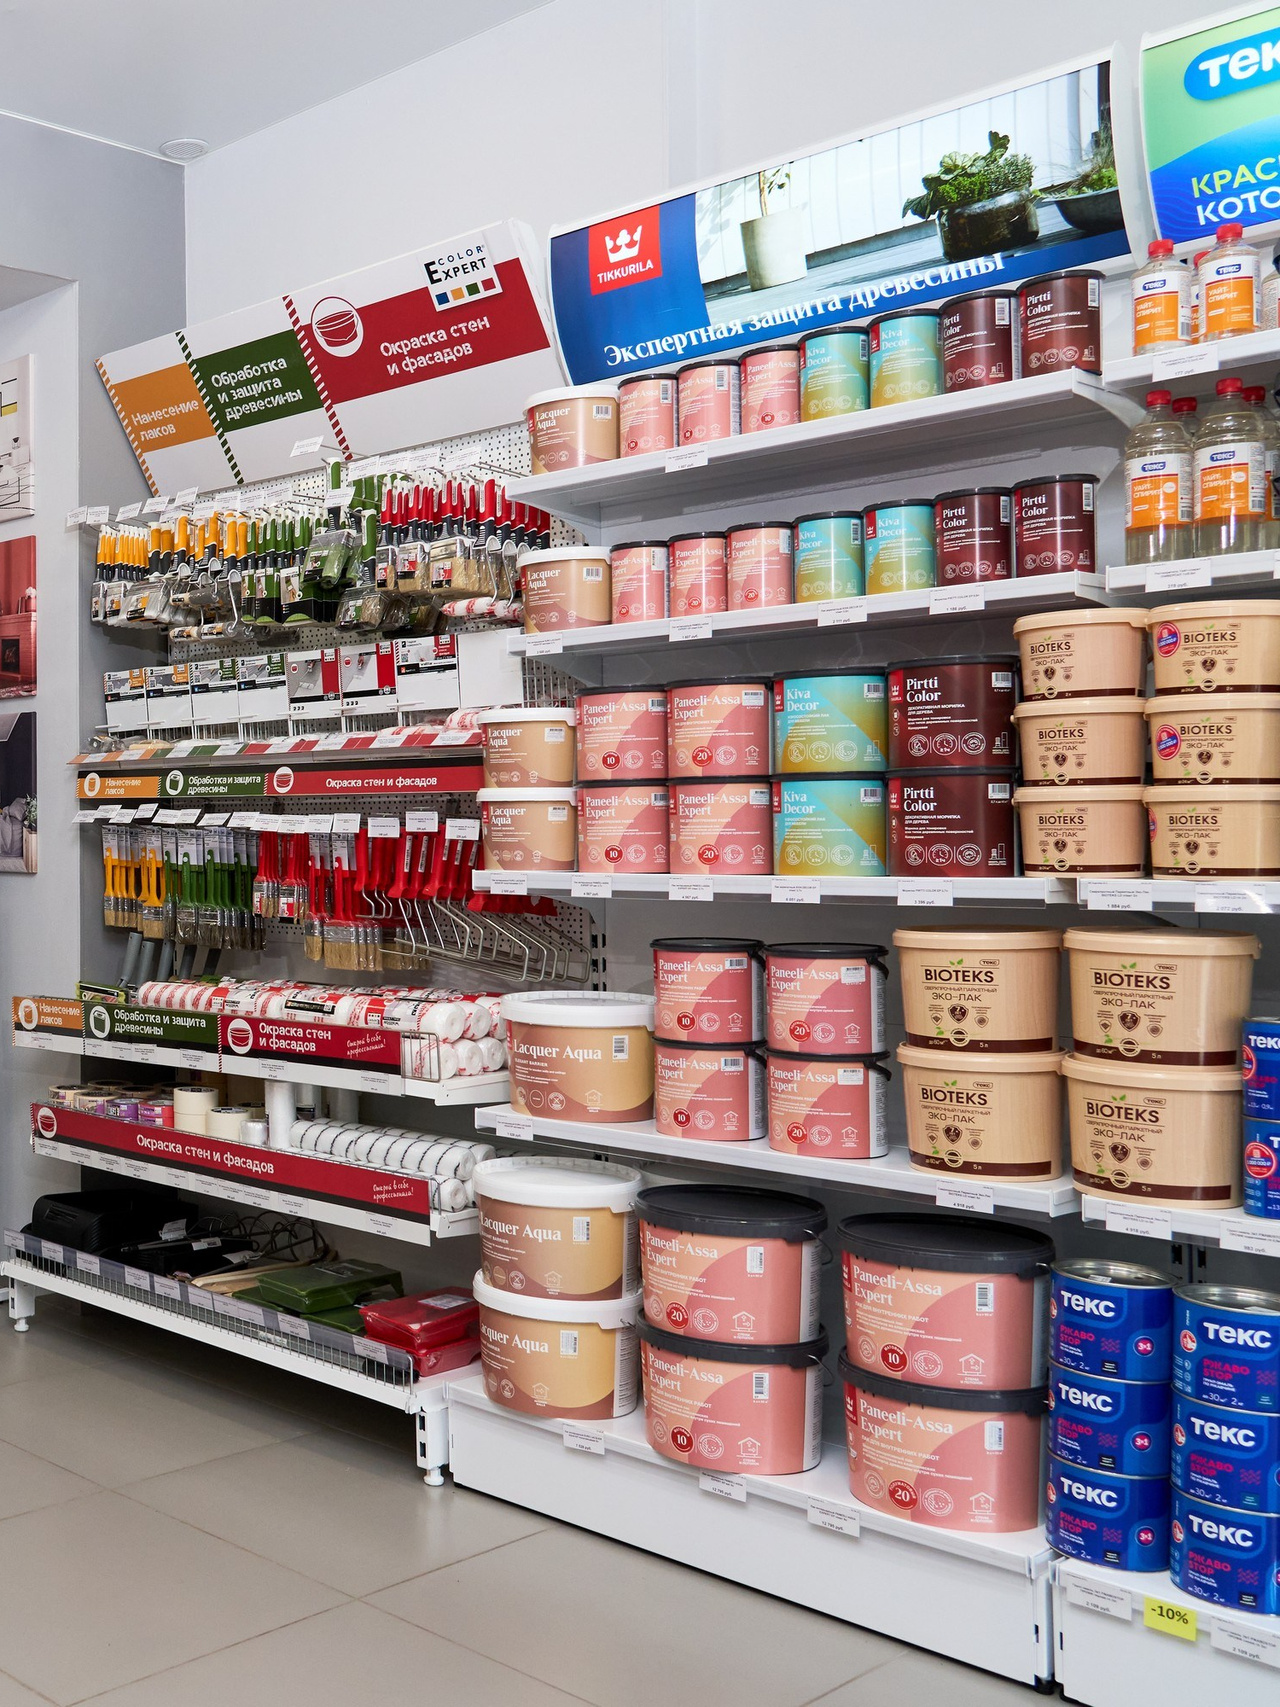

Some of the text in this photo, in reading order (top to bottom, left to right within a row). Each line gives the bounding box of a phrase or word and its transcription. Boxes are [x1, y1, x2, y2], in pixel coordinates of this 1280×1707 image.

[1192, 157, 1280, 198] КРАС
[597, 259, 654, 285] TIKKURILA
[1026, 291, 1051, 307] Pirtti
[604, 252, 1007, 367] Экспертная защита древесины
[1026, 302, 1053, 317] Color
[379, 315, 491, 358] Окраска стен
[387, 341, 473, 376] и фасадов
[211, 355, 288, 388] Обработка
[217, 375, 283, 405] и защита
[224, 388, 304, 422] древесины
[131, 398, 199, 427] Нанесение
[535, 407, 571, 421] Lacquer
[139, 422, 177, 442] лаков
[536, 419, 557, 431] Aqua
[1022, 494, 1046, 507] Pirtti
[942, 506, 966, 518] Pirtti
[1022, 506, 1049, 518] Color
[942, 517, 968, 529] Color
[527, 568, 561, 581] Lacquer
[528, 579, 547, 591] Aqua
[1182, 631, 1237, 644] BIOTEKS
[906, 677, 938, 691] Pirtti
[786, 688, 811, 700] Kiva
[906, 690, 942, 703] Color
[583, 702, 647, 715] Paneeli-Assa
[787, 700, 820, 712] Decor
[583, 713, 613, 726] Expert
[488, 728, 523, 739] Lacquer
[489, 737, 508, 747] Aqua
[606, 756, 616, 764] 10
[105, 778, 142, 788] Нанесение
[187, 776, 226, 787] Обработка
[233, 774, 261, 786] защита
[326, 777, 361, 789] Окраска
[363, 777, 384, 787] стен
[394, 775, 438, 789] фасадов
[105, 787, 125, 796] лаков
[187, 784, 228, 796] древесины
[679, 793, 748, 805] Paneeli-Assa
[679, 805, 712, 818] Expert
[1038, 815, 1084, 825] BIOTEKS
[702, 849, 714, 859] 20
[659, 958, 723, 973] Paneeli-Assa
[659, 970, 688, 983] Expert
[771, 965, 839, 981] Paneeli-Assa
[924, 968, 995, 984] BIOTEKS
[771, 978, 801, 992] Expert
[1093, 971, 1170, 991] BIOTEKS
[931, 992, 982, 1002] ЭКО-ЛАК
[1101, 997, 1156, 1010] ЭКО-ЛАК
[39, 1001, 80, 1017] Нанесение
[40, 1013, 64, 1027] лаков
[114, 1008, 160, 1025] Обработка
[171, 1016, 207, 1030] защита
[681, 1017, 690, 1026] 10
[113, 1020, 164, 1037] древесины
[258, 1023, 332, 1041] Окраска стен
[794, 1026, 806, 1036] 20
[269, 1036, 316, 1053] фасадов
[514, 1039, 602, 1062] Lacquer Aqua
[921, 1087, 988, 1106] BIOTEKS
[928, 1112, 976, 1124] ЭКО-ЛАК
[1086, 1101, 1160, 1124] BIOTEKS
[1093, 1128, 1146, 1143] ЭКО-ЛАК
[136, 1133, 183, 1155] Окраска
[184, 1145, 210, 1160] стен
[223, 1151, 275, 1174] фасадов
[480, 1211, 562, 1242] Lacquer Aqua
[646, 1230, 718, 1260] Paneeli-Assa
[646, 1247, 677, 1268] Expert
[853, 1264, 942, 1297] Paneeli-Assa
[854, 1285, 893, 1307] Expert
[670, 1309, 683, 1322] 20
[888, 1352, 900, 1365] 10
[860, 1397, 953, 1436] Paneeli-Assa
[861, 1419, 902, 1443] Expert
[894, 1487, 910, 1502] 20
[1150, 1604, 1189, 1626] -10%
